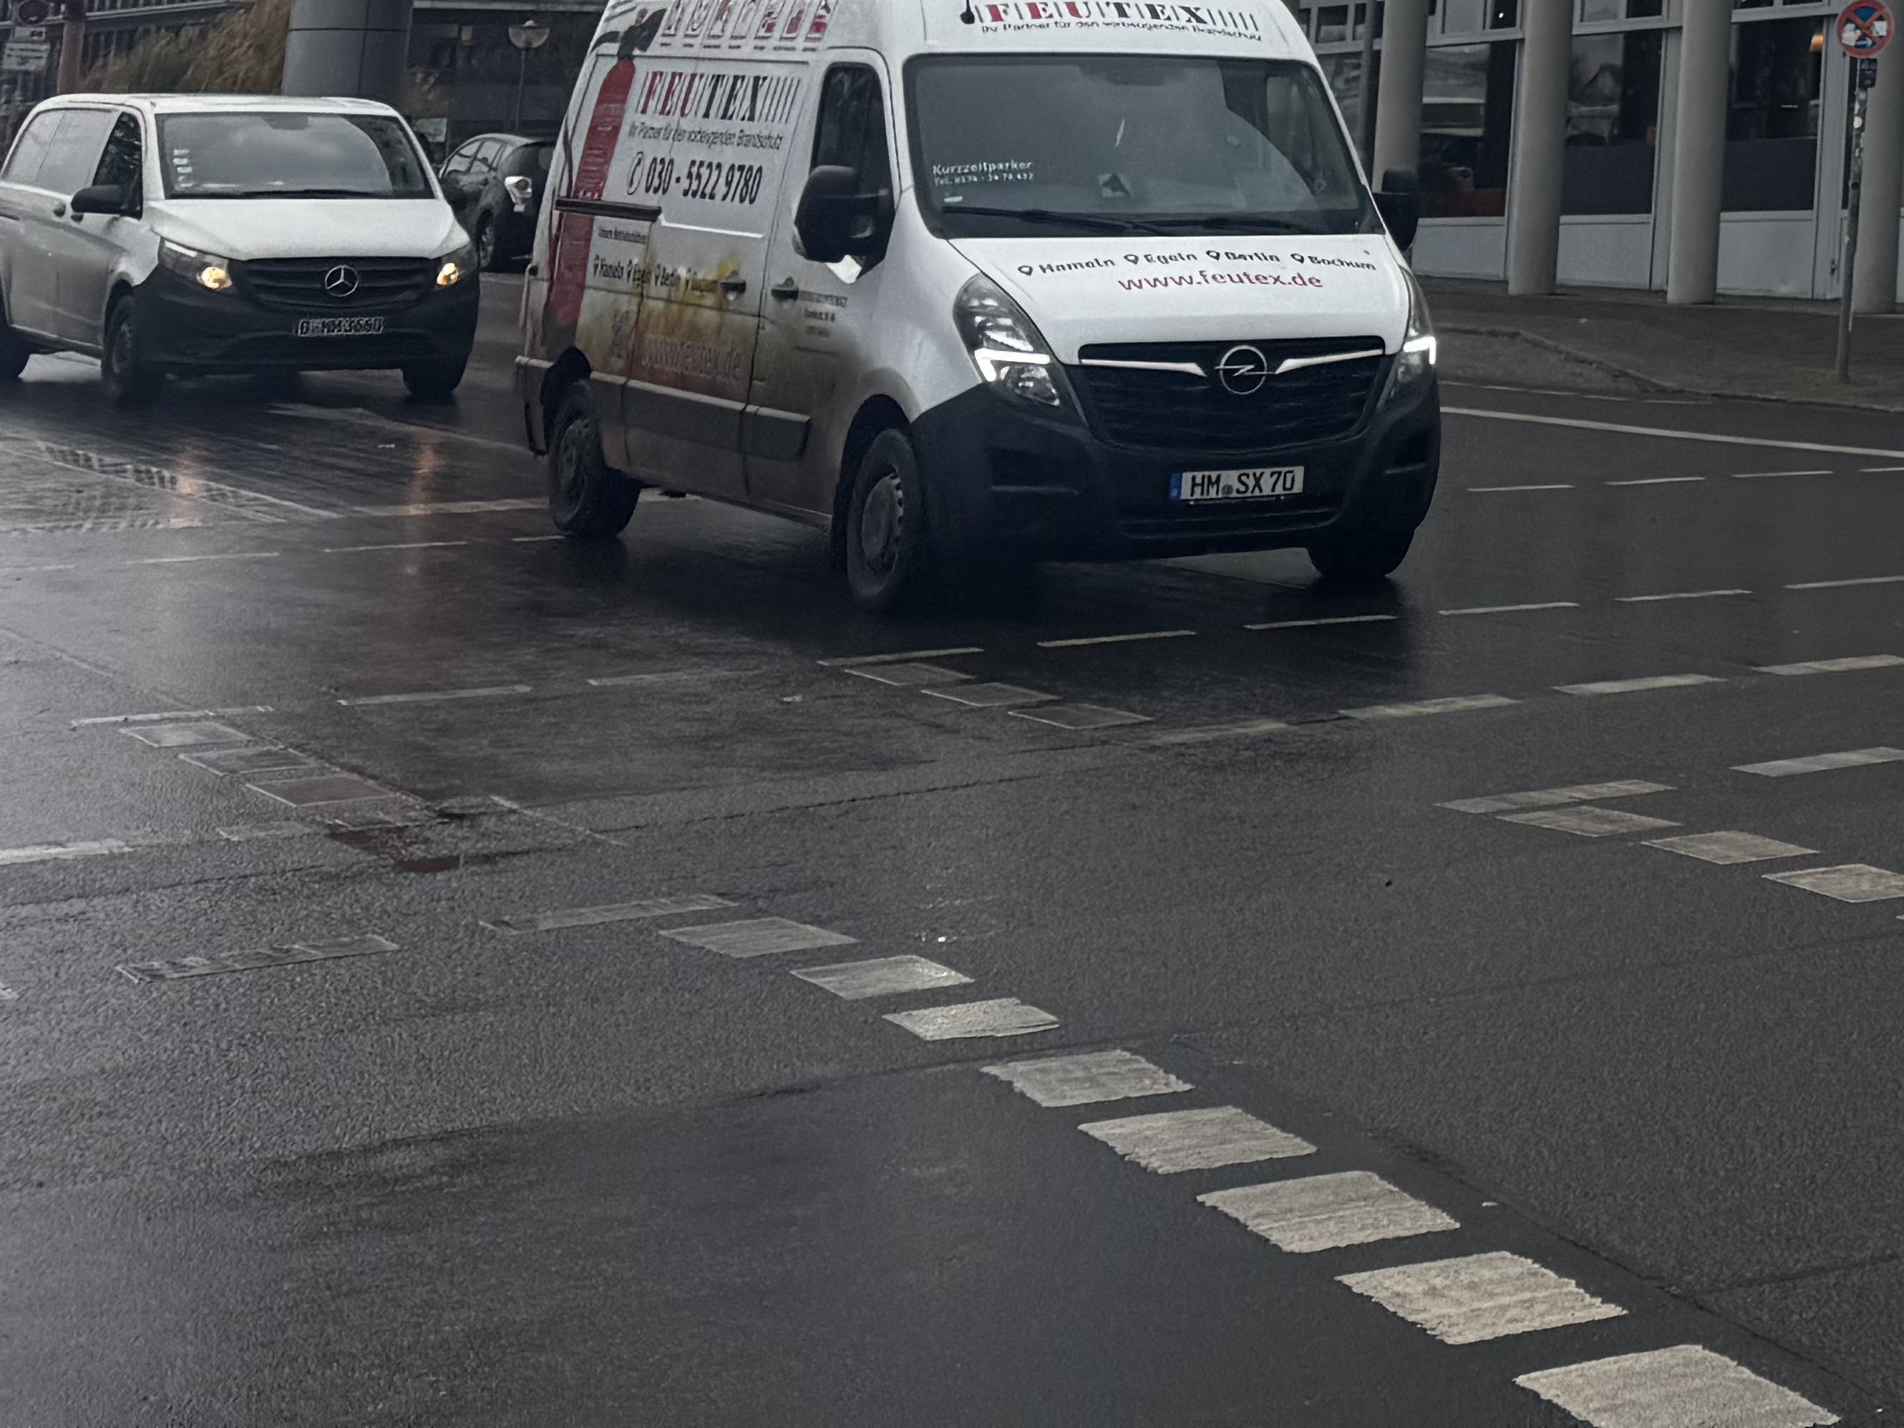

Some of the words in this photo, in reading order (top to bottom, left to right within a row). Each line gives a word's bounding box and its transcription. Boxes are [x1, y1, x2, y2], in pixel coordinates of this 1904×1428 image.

[986, 1, 1208, 25] FEUTEX
[640, 70, 768, 123] FEUTEX
[645, 157, 674, 195] 030
[683, 160, 722, 201] 5522
[721, 164, 763, 205] 9780
[1039, 257, 1116, 274] Hameln
[1144, 251, 1198, 266] Egeln
[1224, 250, 1280, 263] Berlin
[1308, 255, 1377, 271] Bochum
[1118, 270, 1323, 292] www.feutex.de
[1190, 473, 1222, 497] HM
[1236, 472, 1264, 494] SX
[1270, 470, 1295, 492] 70
